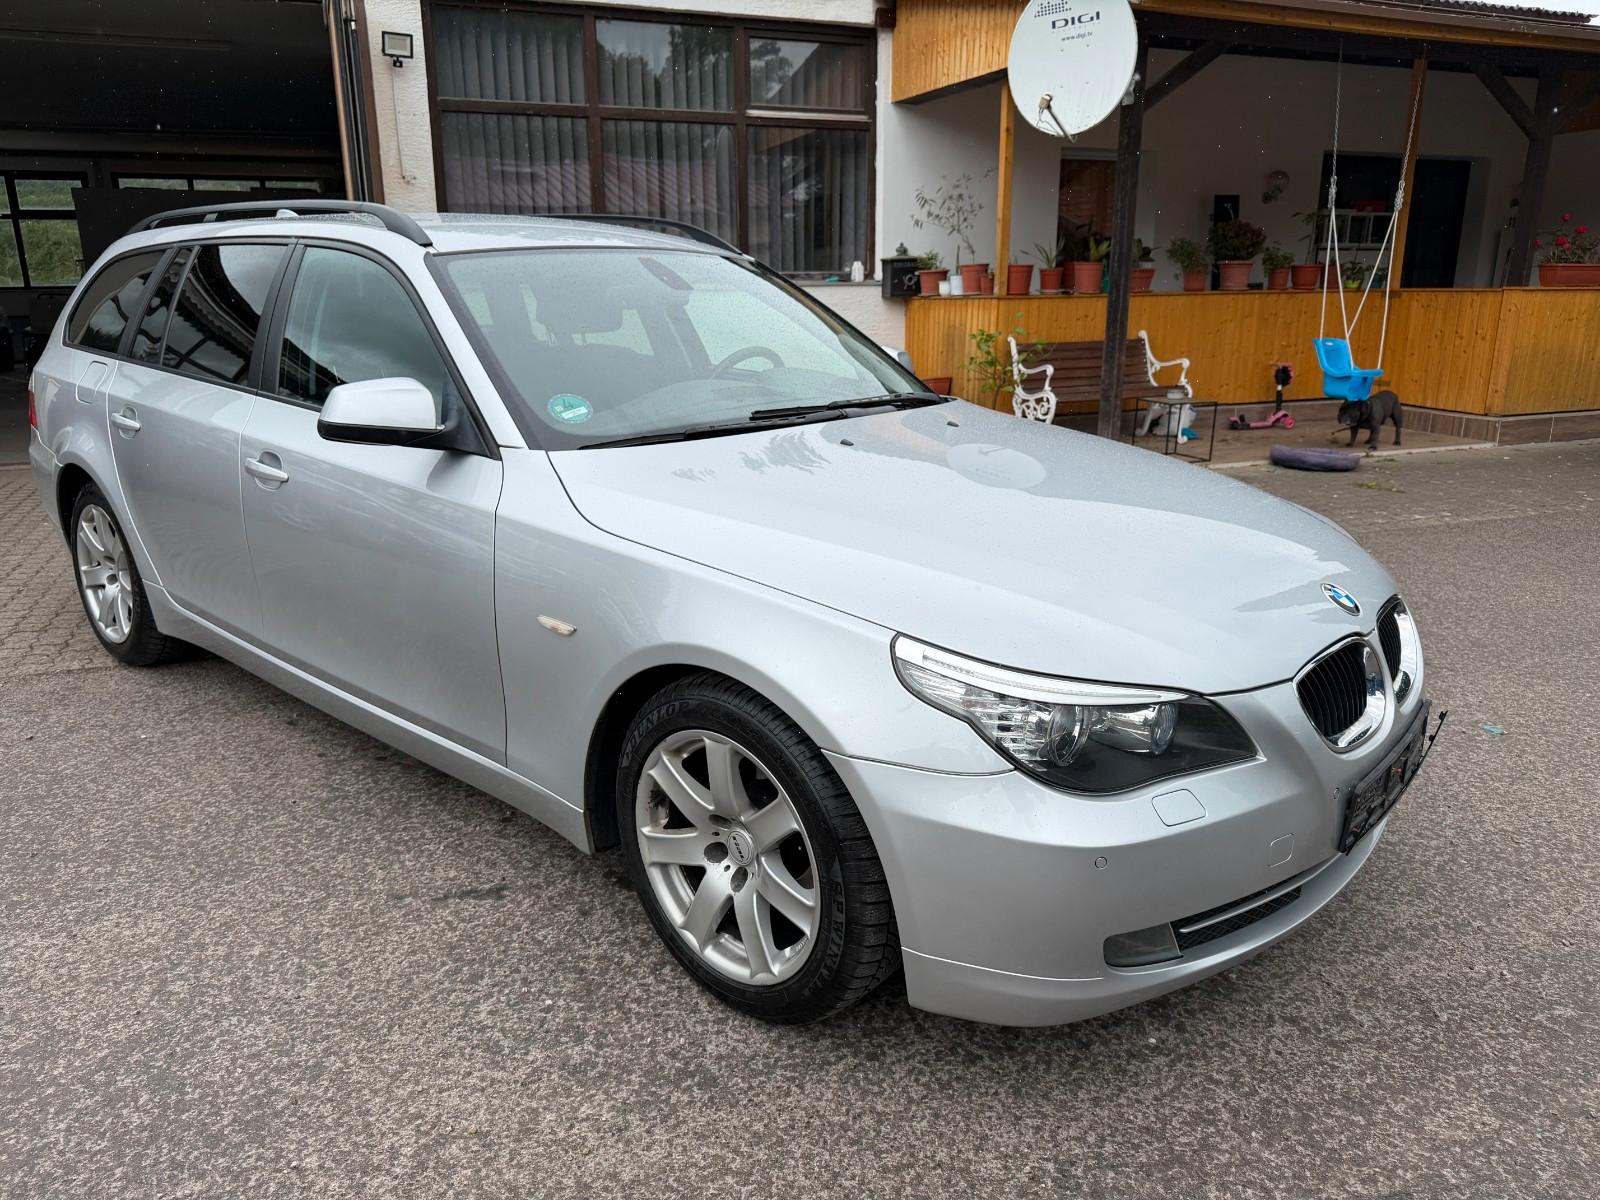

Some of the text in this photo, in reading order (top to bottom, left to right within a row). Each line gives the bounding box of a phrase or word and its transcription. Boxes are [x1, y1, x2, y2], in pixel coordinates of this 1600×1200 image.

[1051, 11, 1100, 29] DIGI
[1061, 31, 1093, 41] www.digi.tv
[628, 700, 690, 750] DUNLOP
